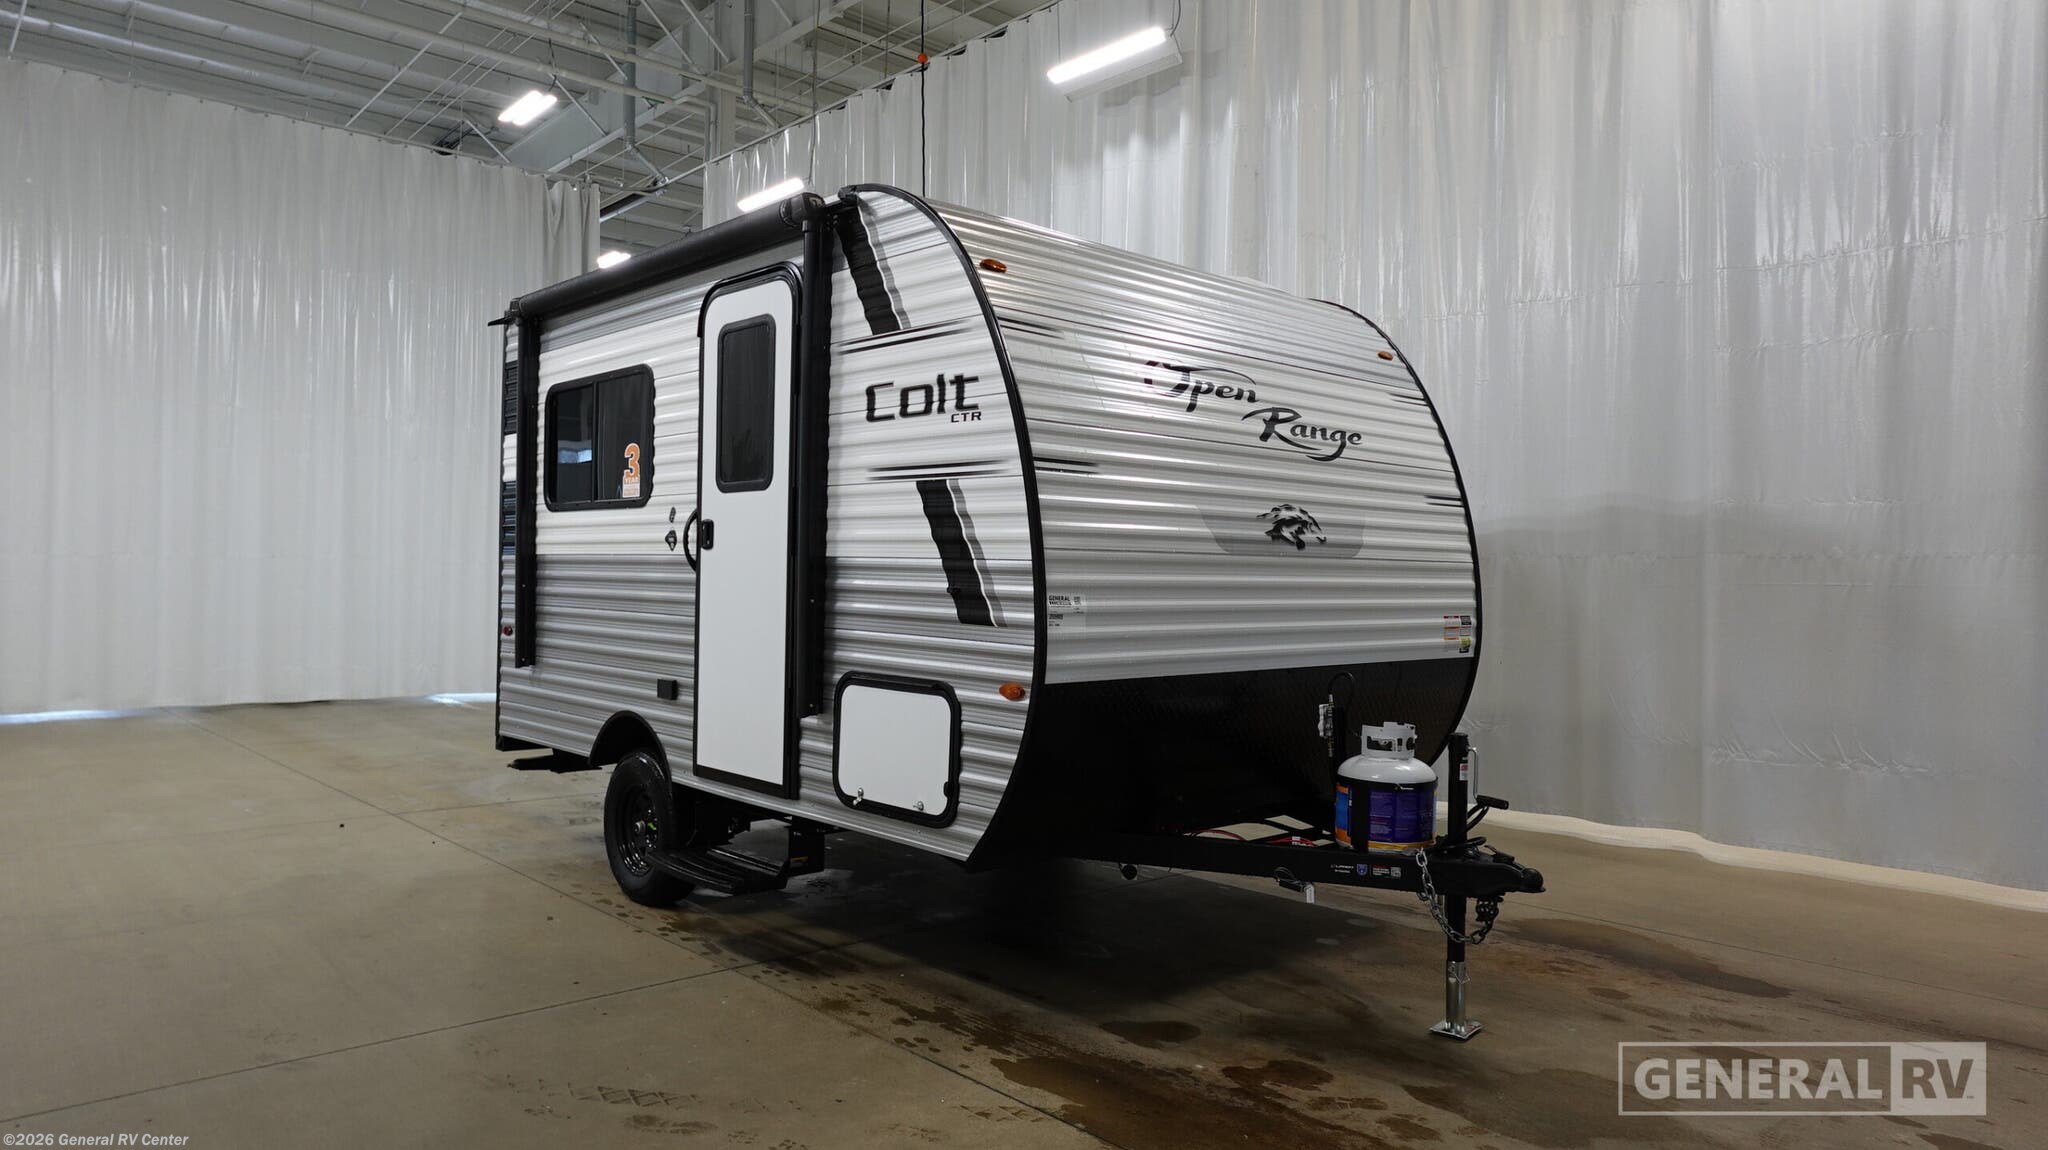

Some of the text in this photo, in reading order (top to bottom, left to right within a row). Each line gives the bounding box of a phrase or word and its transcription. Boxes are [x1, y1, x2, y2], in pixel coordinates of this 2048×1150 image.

[865, 373, 980, 423] Colt
[950, 411, 982, 423] CTR
[1241, 406, 1363, 462] Range
[624, 442, 640, 478] 3
